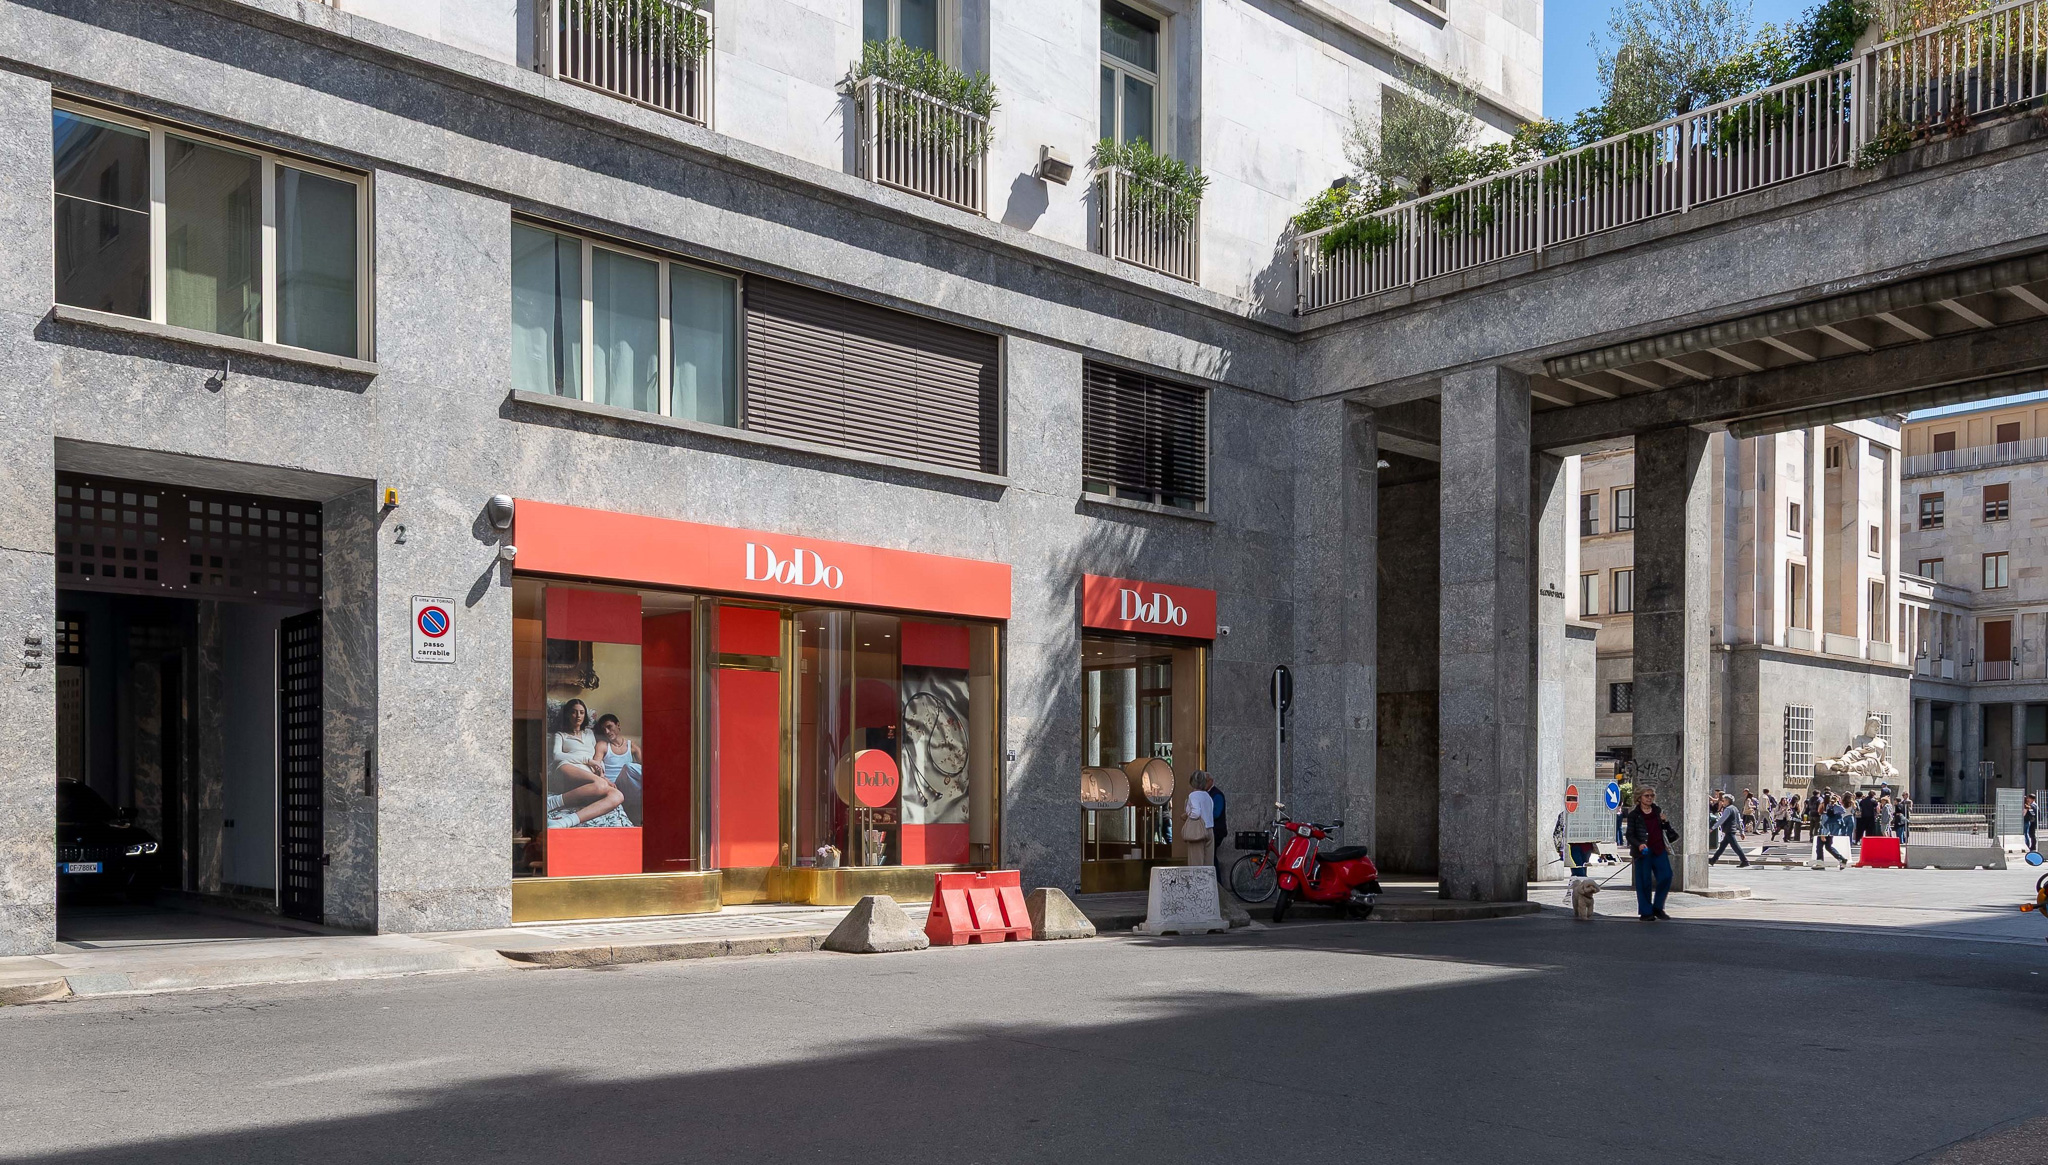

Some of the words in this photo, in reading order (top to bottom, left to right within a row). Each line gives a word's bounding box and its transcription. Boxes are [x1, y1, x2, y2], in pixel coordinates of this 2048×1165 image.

[393, 523, 407, 545] 2
[744, 542, 844, 590] DoDo
[1119, 588, 1188, 627] DoDo
[856, 771, 895, 787] DoDo
